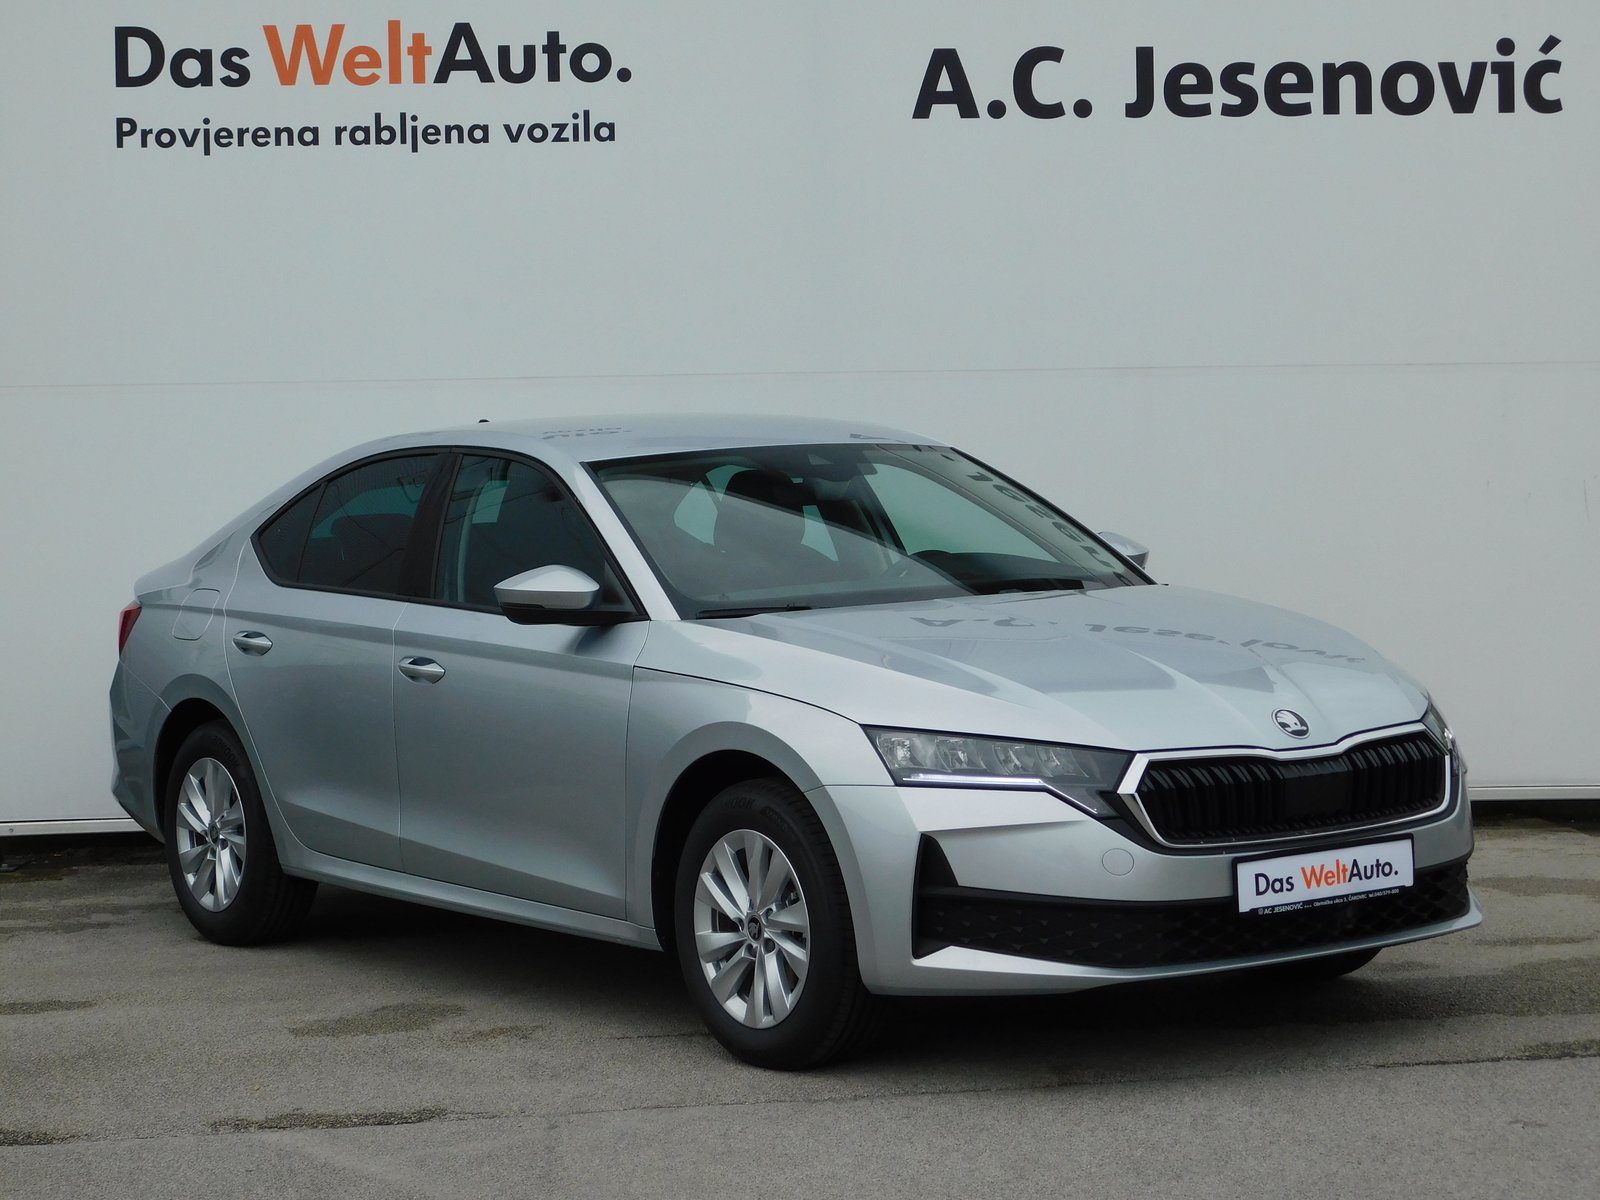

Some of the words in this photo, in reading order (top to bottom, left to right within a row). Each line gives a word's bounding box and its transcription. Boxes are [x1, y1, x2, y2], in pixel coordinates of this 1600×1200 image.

[114, 25, 251, 89] Das
[262, 19, 632, 87] WeltAuto.
[911, 45, 1093, 120] A.C.
[1124, 34, 1564, 119] Jesenović
[115, 116, 320, 157] Provjerena
[334, 111, 490, 154] rabljena
[502, 109, 616, 144] vozila
[1254, 872, 1295, 897] Das
[1300, 858, 1399, 890] WeltAuto.
[1263, 907, 1273, 915] AC
[1273, 902, 1304, 913] JESENOVIĆ
